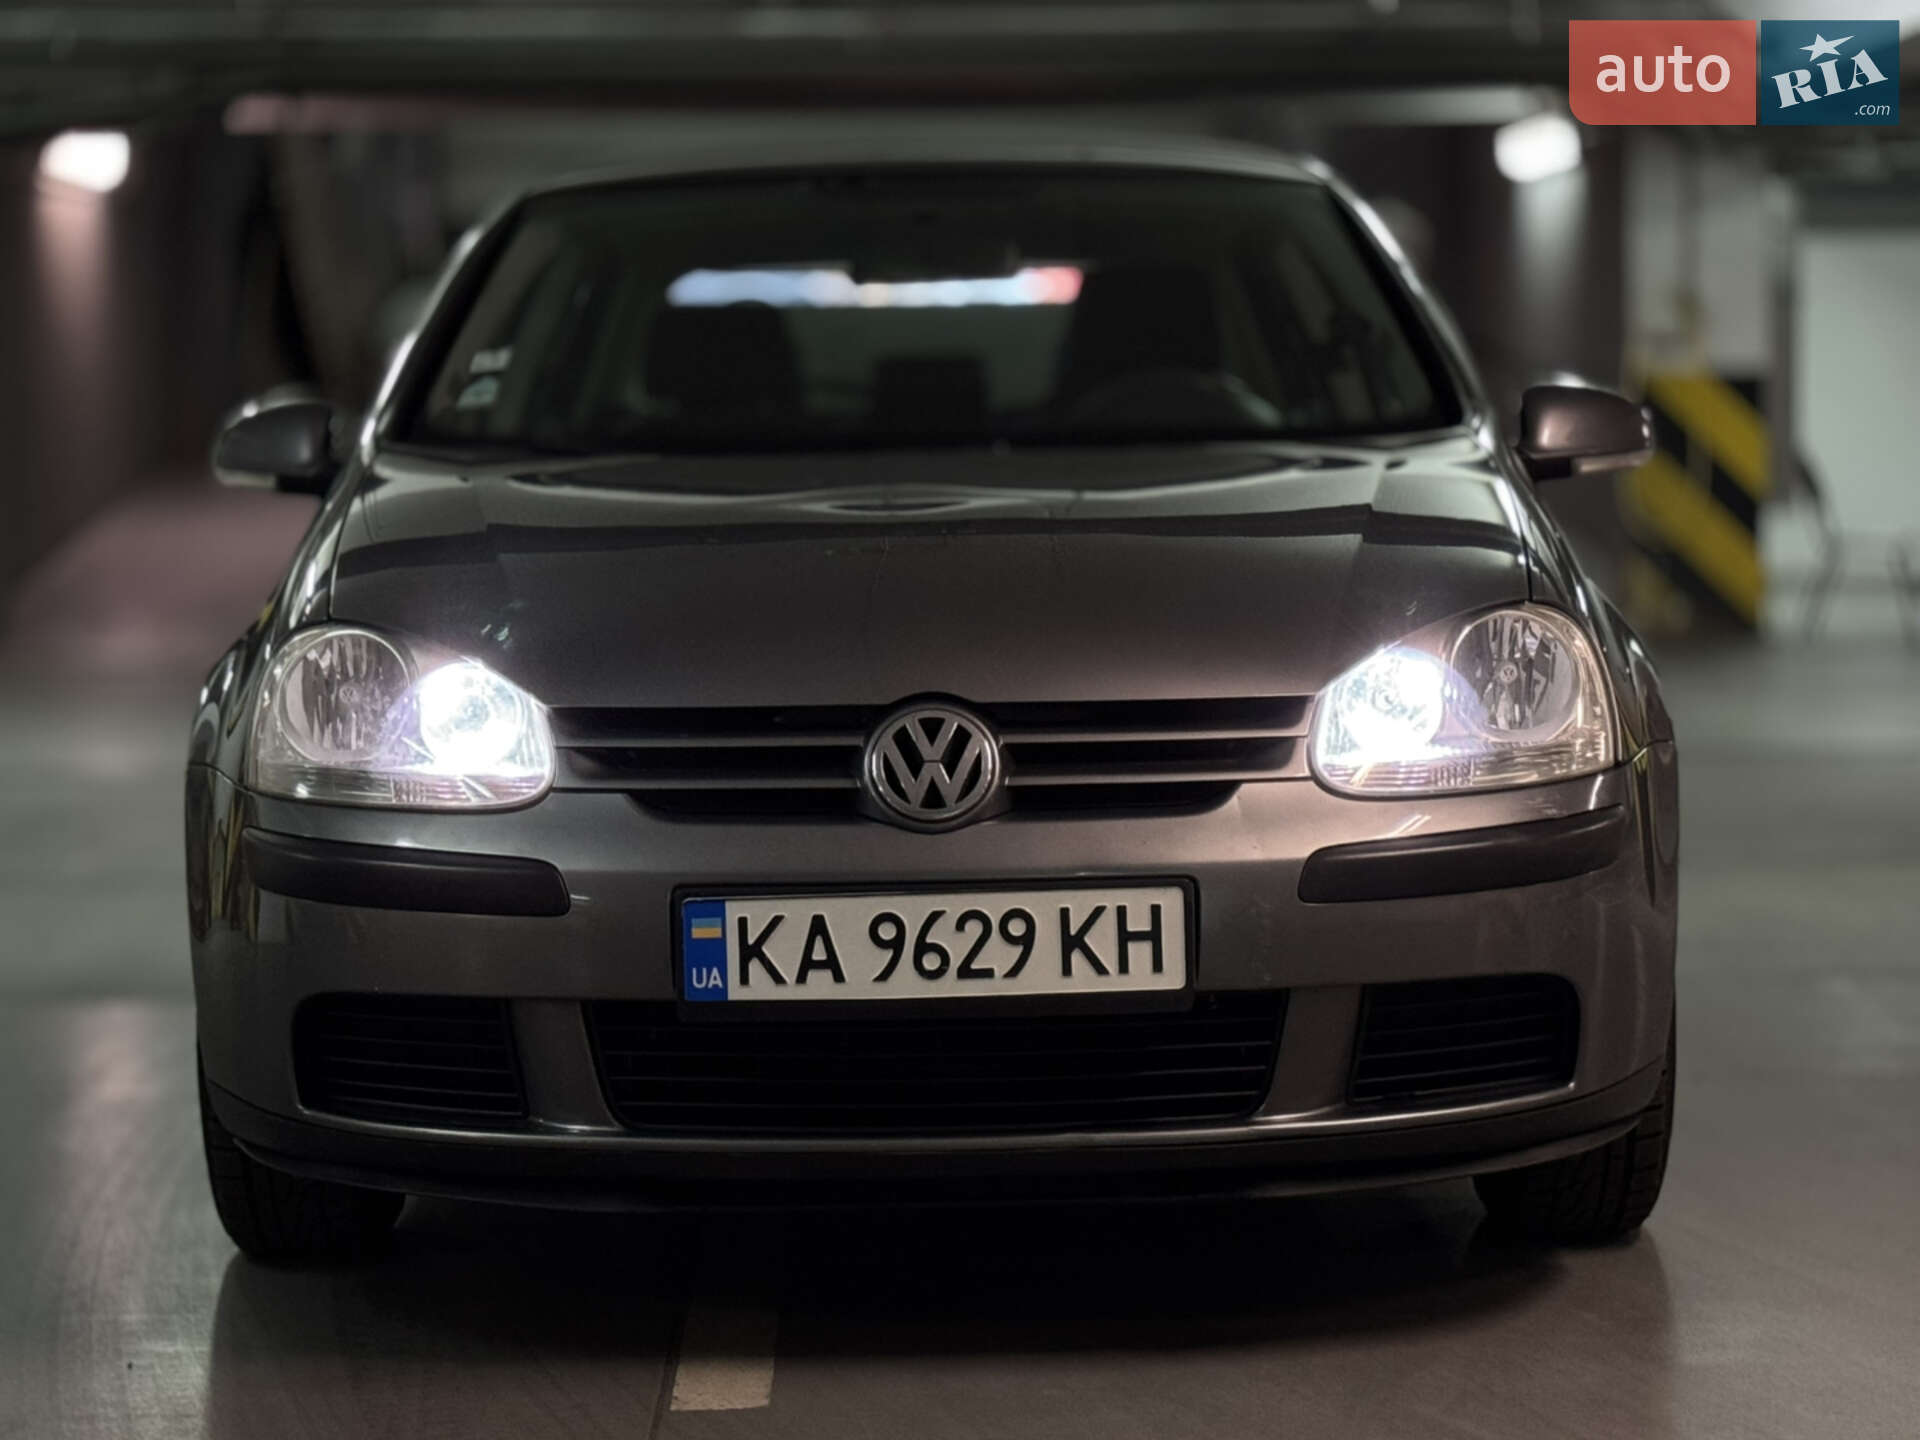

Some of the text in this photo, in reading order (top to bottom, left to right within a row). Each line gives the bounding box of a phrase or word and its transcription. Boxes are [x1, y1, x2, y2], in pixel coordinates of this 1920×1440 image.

[880, 711, 984, 811] VW
[692, 968, 723, 989] UA
[737, 904, 1164, 986] KA 9629 KH
